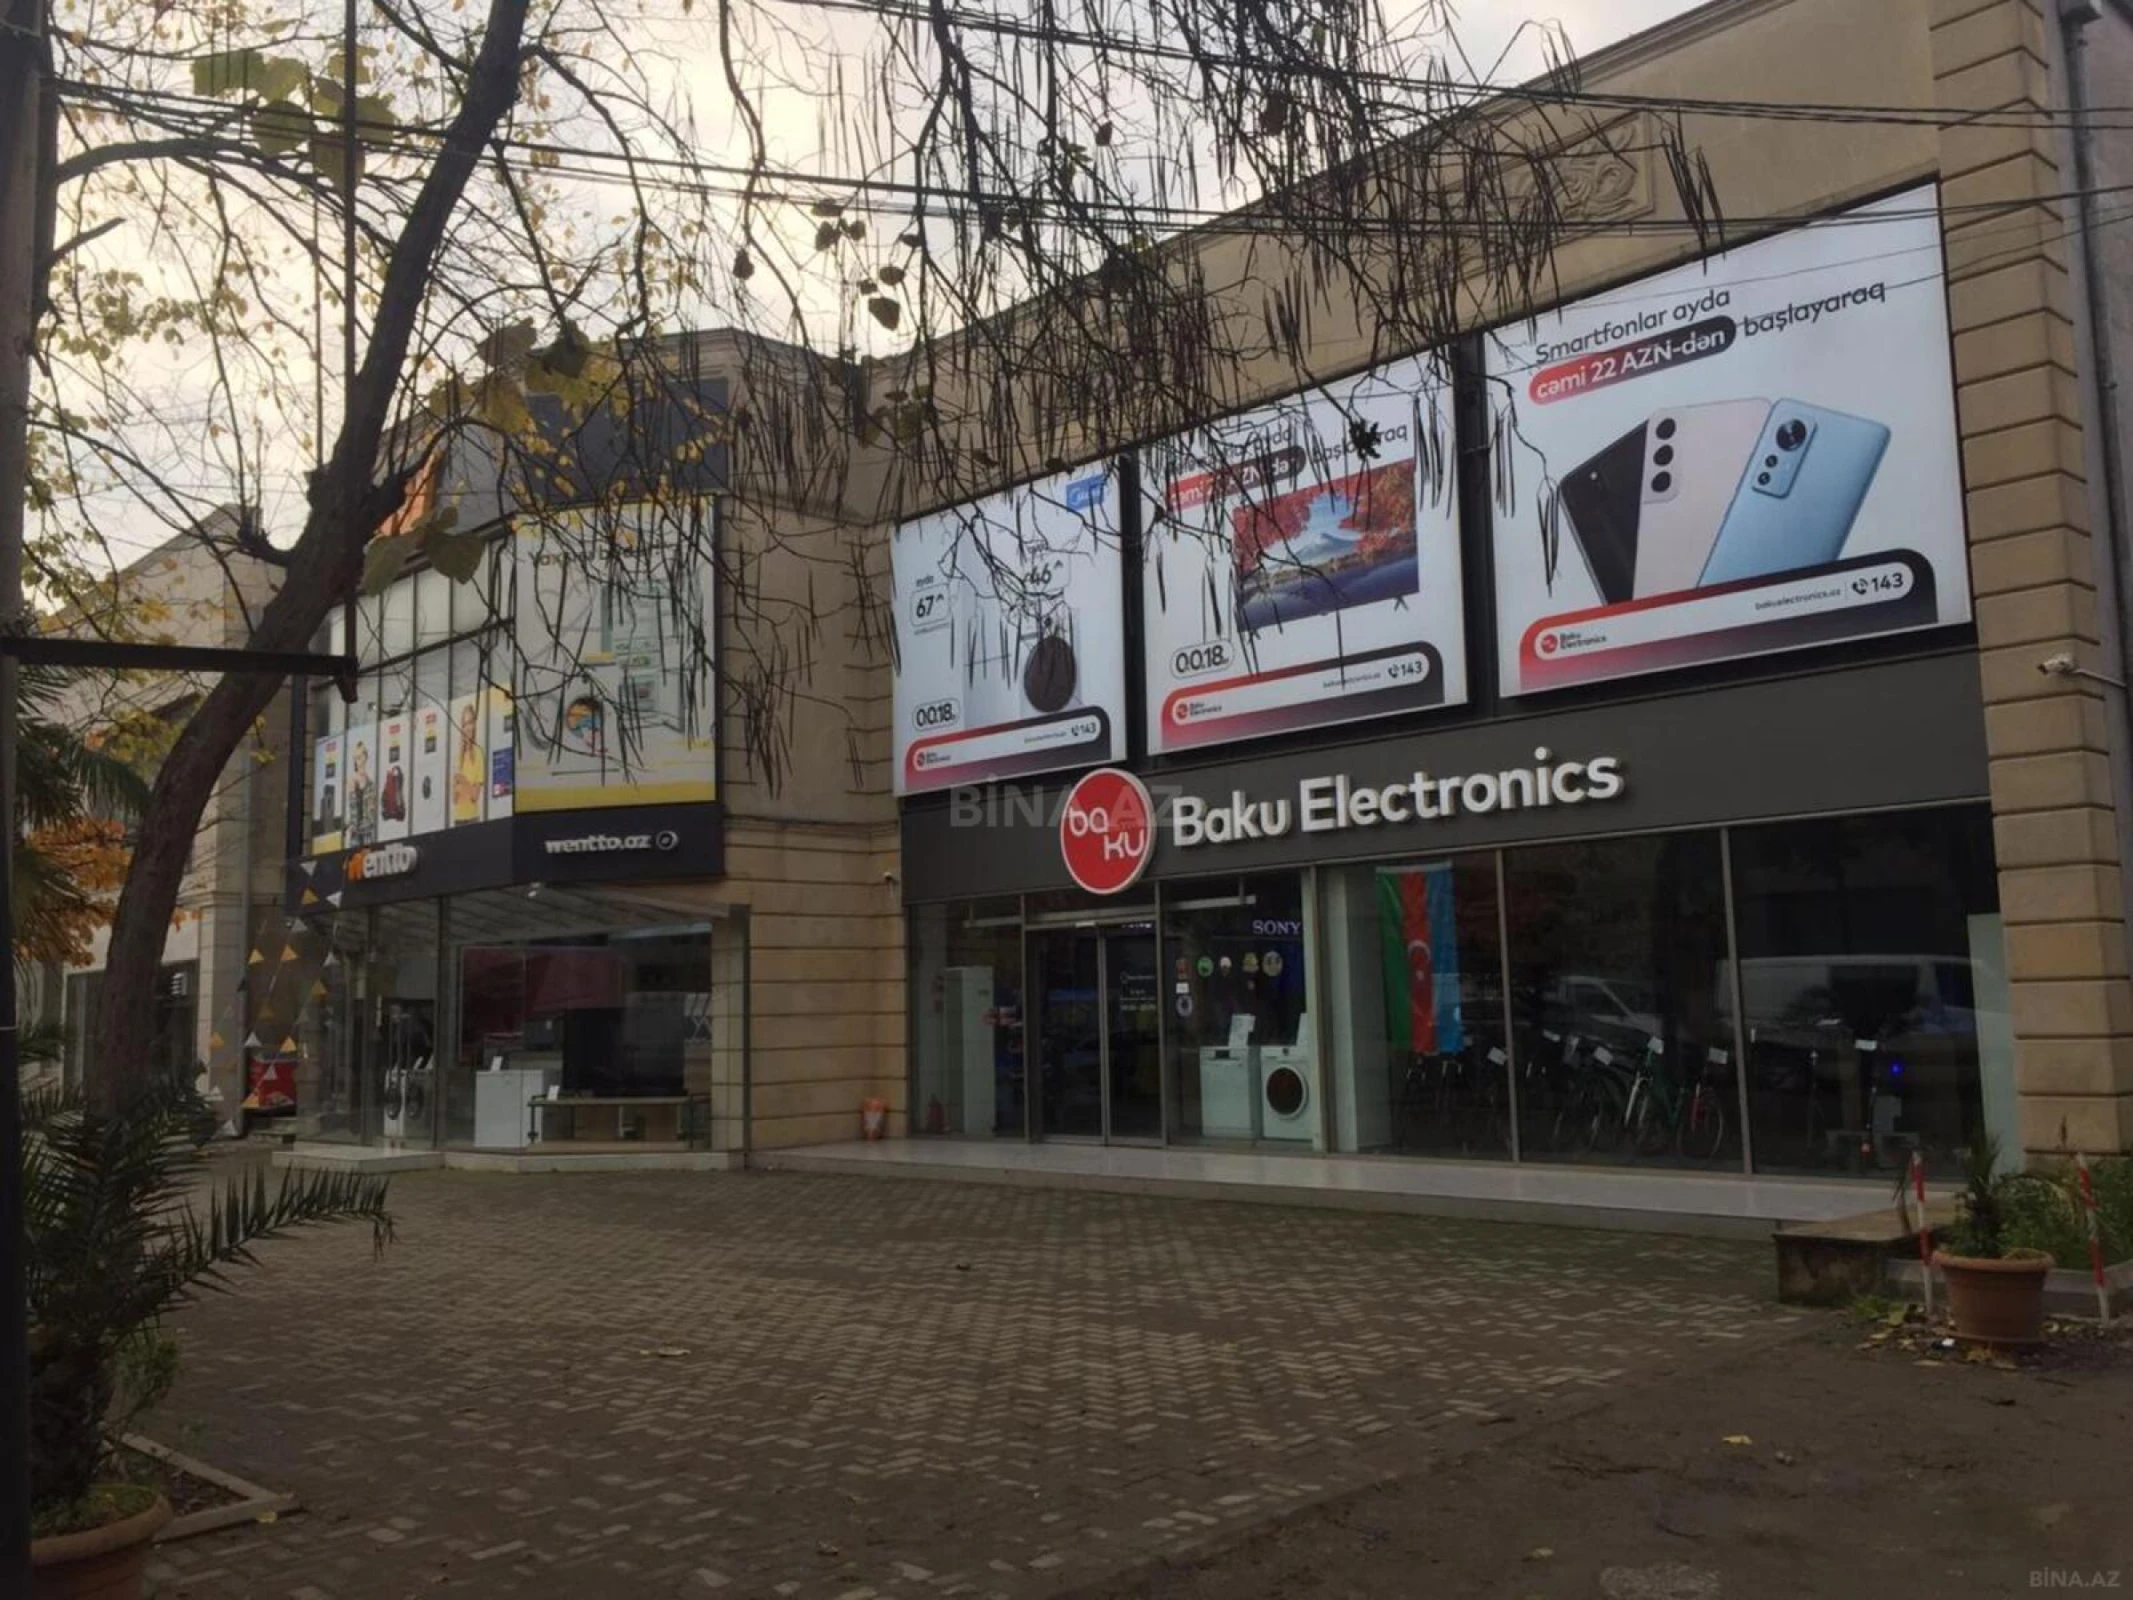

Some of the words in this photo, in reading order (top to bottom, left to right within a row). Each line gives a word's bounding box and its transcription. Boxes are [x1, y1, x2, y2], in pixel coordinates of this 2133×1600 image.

[1743, 281, 1886, 338] başlayaraq
[1535, 310, 1667, 364] Smartfonlar
[1673, 288, 1731, 325] ayda
[1537, 365, 1586, 398] cəmi
[1591, 360, 1617, 383] 22
[1620, 328, 1726, 374] AZN-dən
[1872, 572, 1904, 593] 143
[1400, 660, 1423, 677] 143
[1080, 722, 1097, 735] 143
[1172, 790, 1292, 847] Baku
[1299, 746, 1627, 833] Electronics
[545, 833, 651, 853] wentto.az
[1252, 919, 1301, 935] SONY
